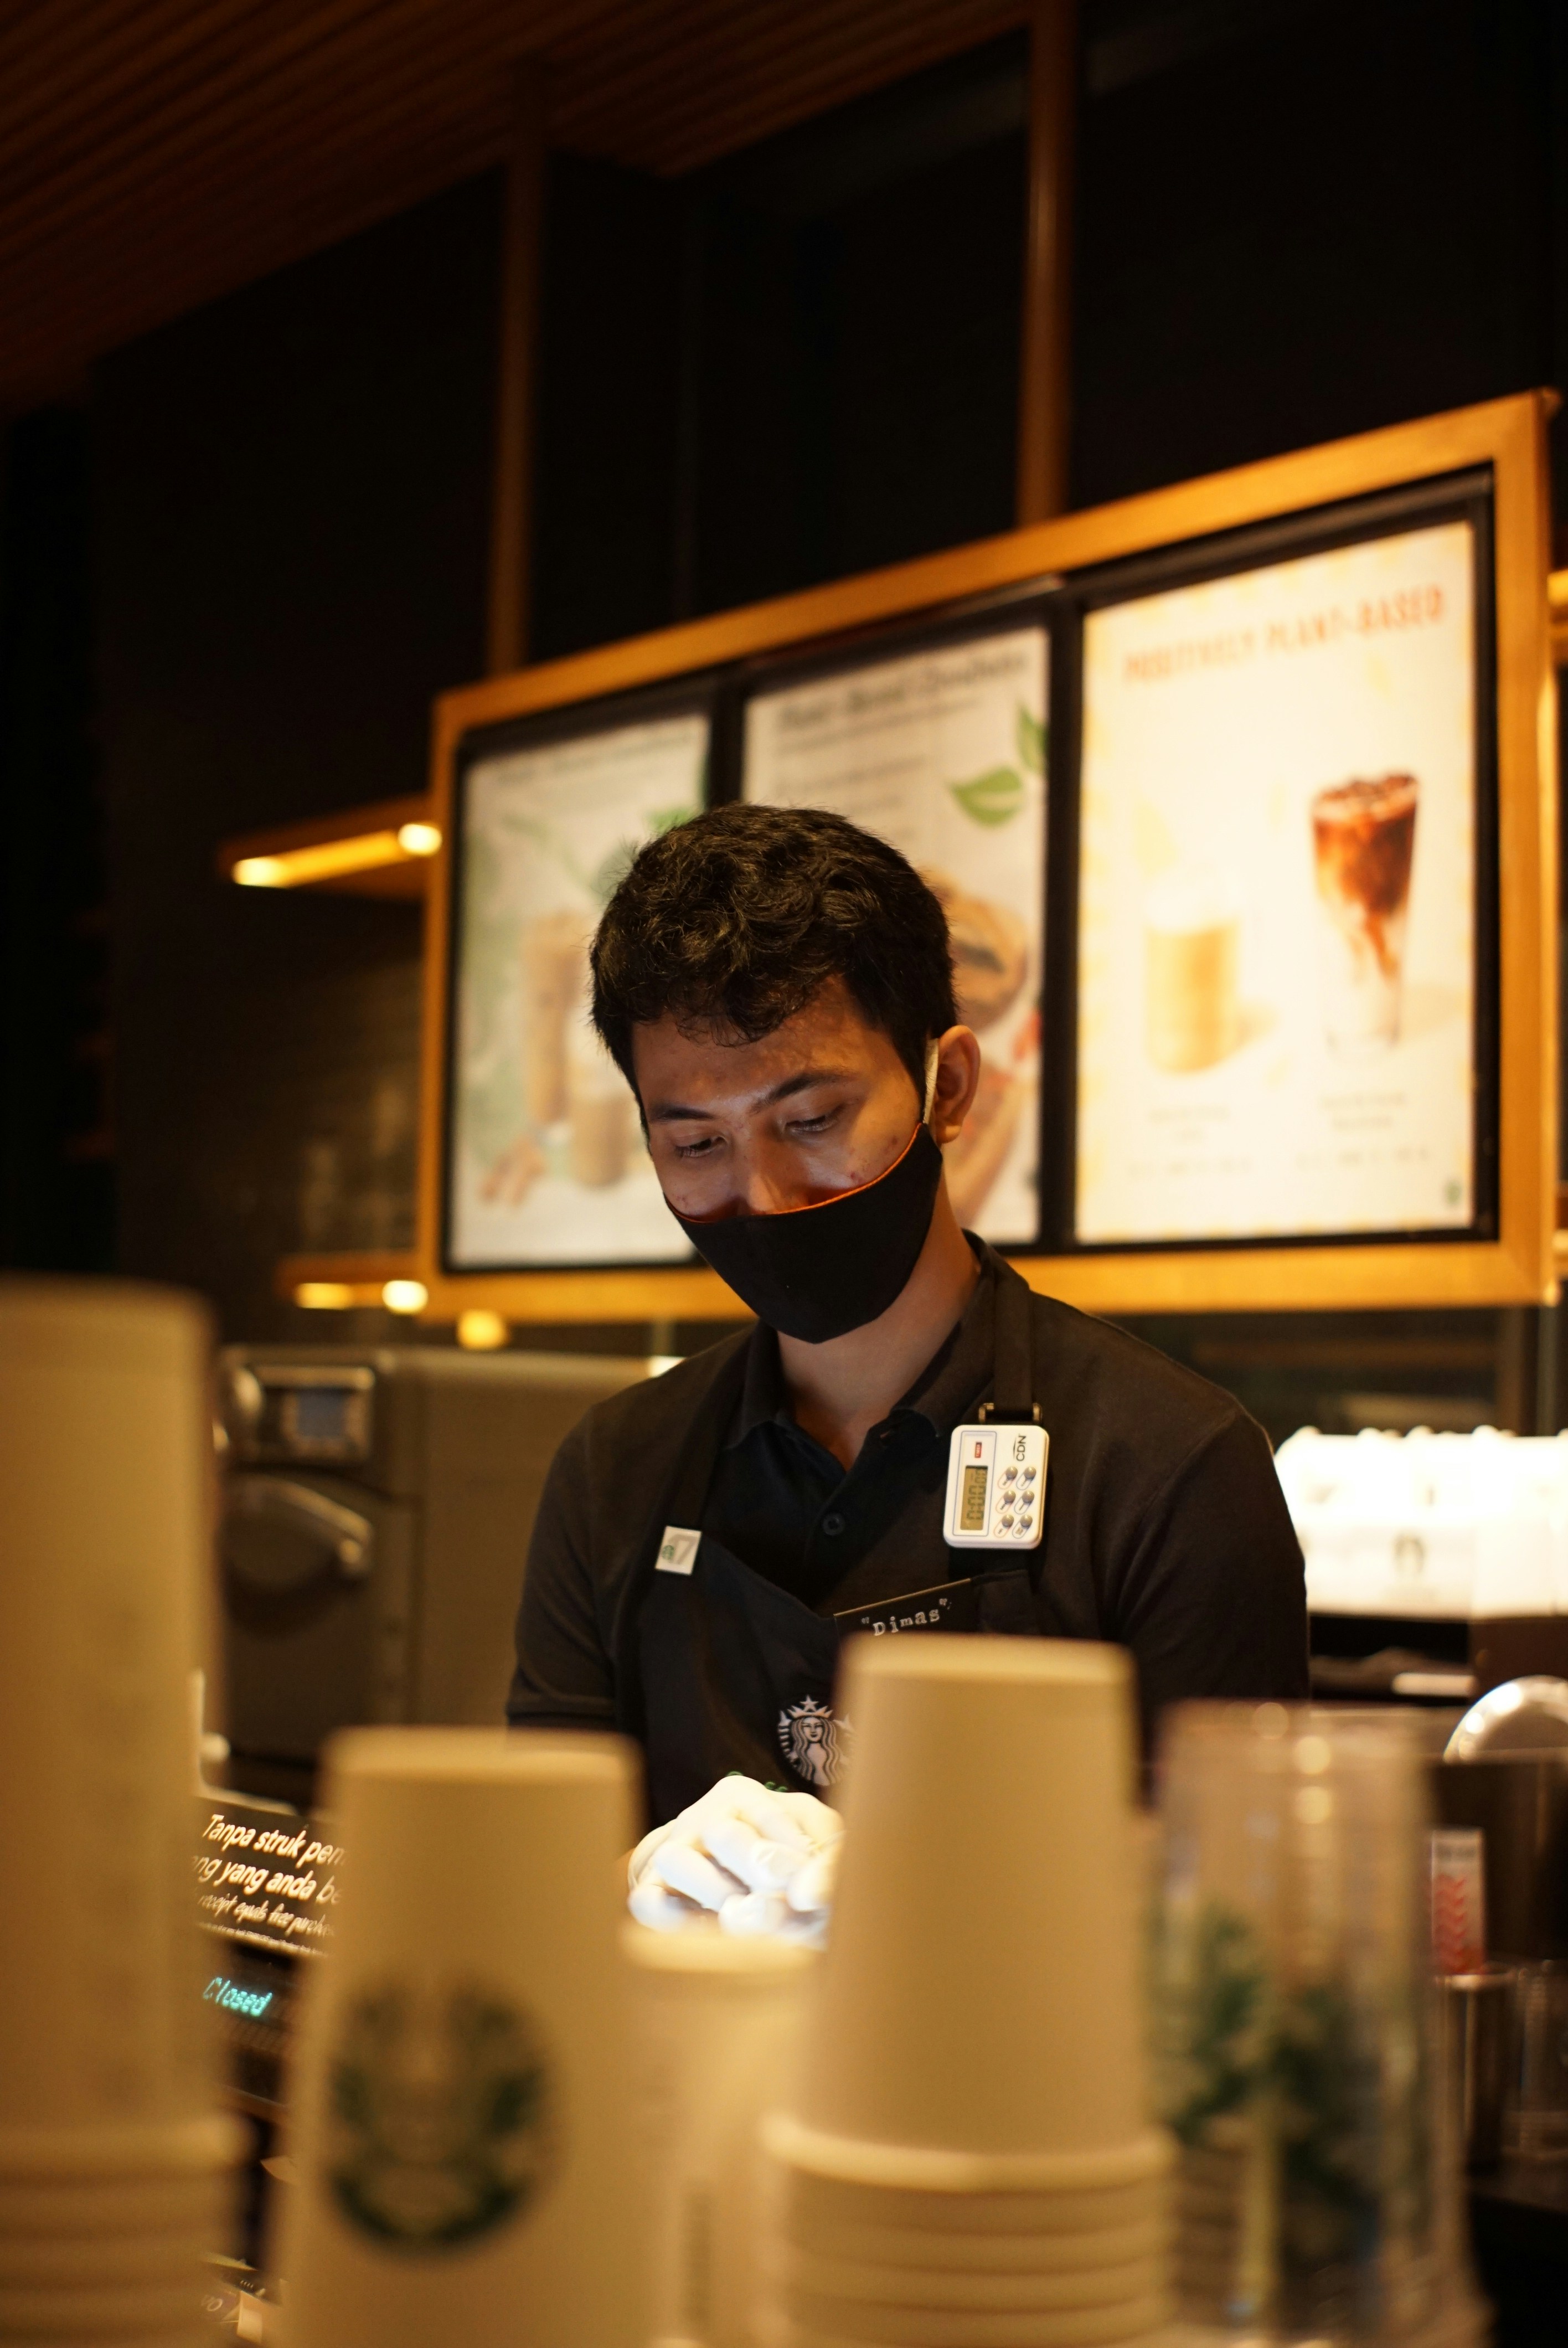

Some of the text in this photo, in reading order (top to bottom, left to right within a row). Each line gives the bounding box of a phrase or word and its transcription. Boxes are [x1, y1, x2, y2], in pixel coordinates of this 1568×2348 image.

[1016, 1435, 1027, 1462] CDN
[202, 1814, 256, 1852] Tanpa
[253, 1829, 306, 1859] struk
[213, 1861, 269, 1896] yang
[265, 1870, 317, 1901] anda
[198, 1893, 238, 1917] receipt
[233, 1900, 269, 1924] equals
[267, 1903, 294, 1928] free
[203, 1977, 272, 2017] Closed
